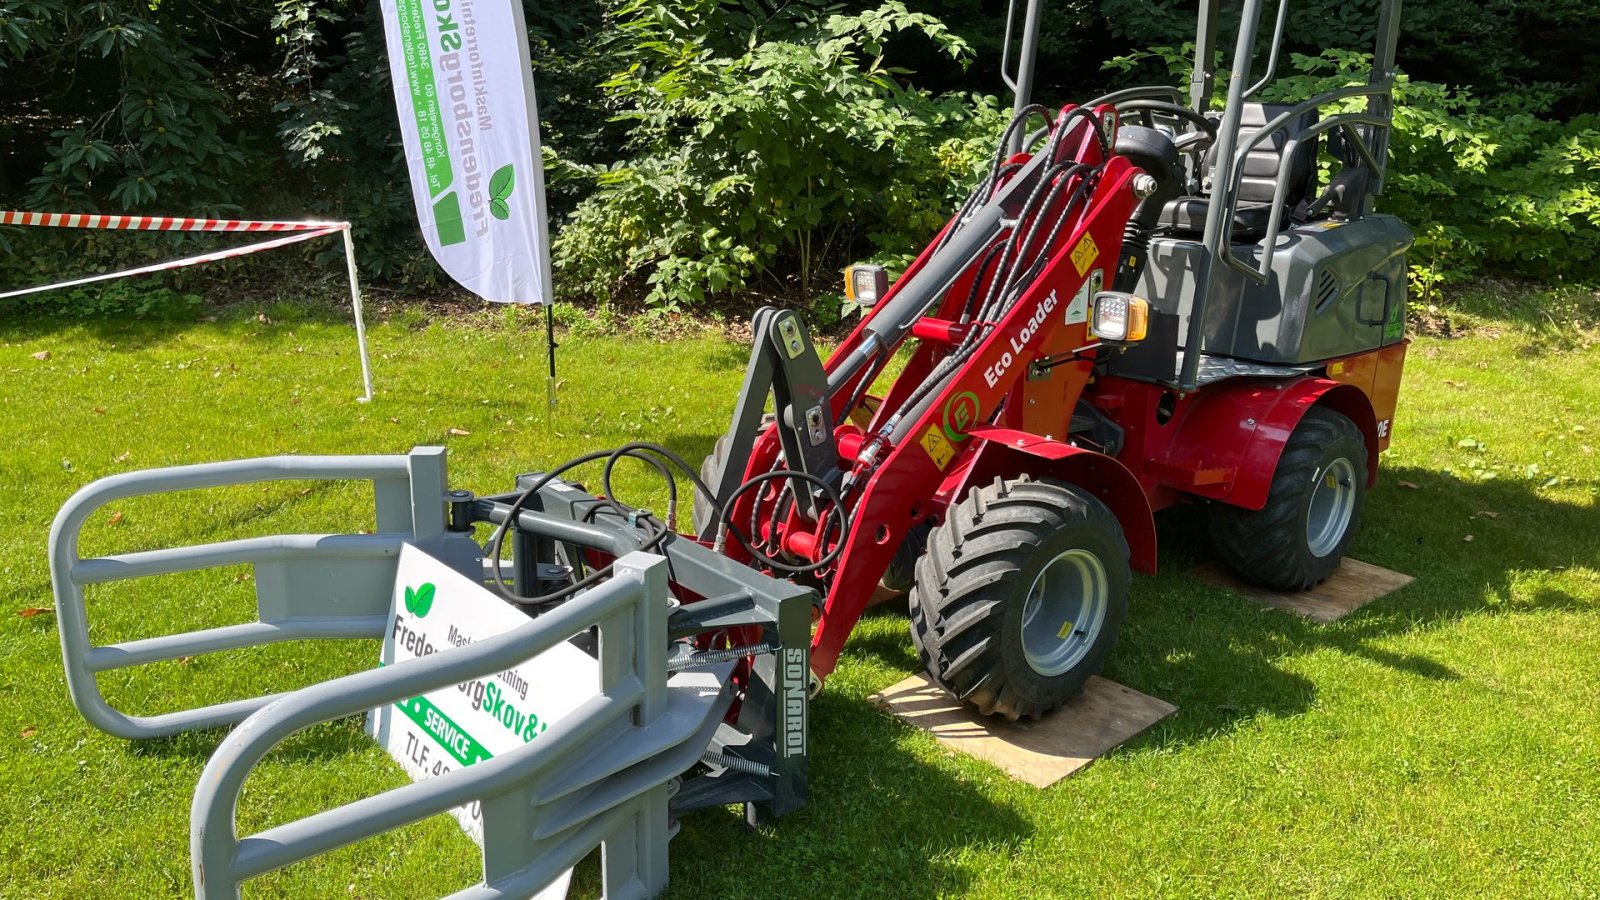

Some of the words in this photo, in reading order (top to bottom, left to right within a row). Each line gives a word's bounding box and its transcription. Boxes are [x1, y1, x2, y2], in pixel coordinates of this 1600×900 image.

[983, 352, 1013, 389] Eco
[1009, 288, 1058, 355] Loader
[424, 707, 471, 760] SERVICE
[783, 648, 806, 758] SONAROL
[405, 731, 430, 773] TLF.
